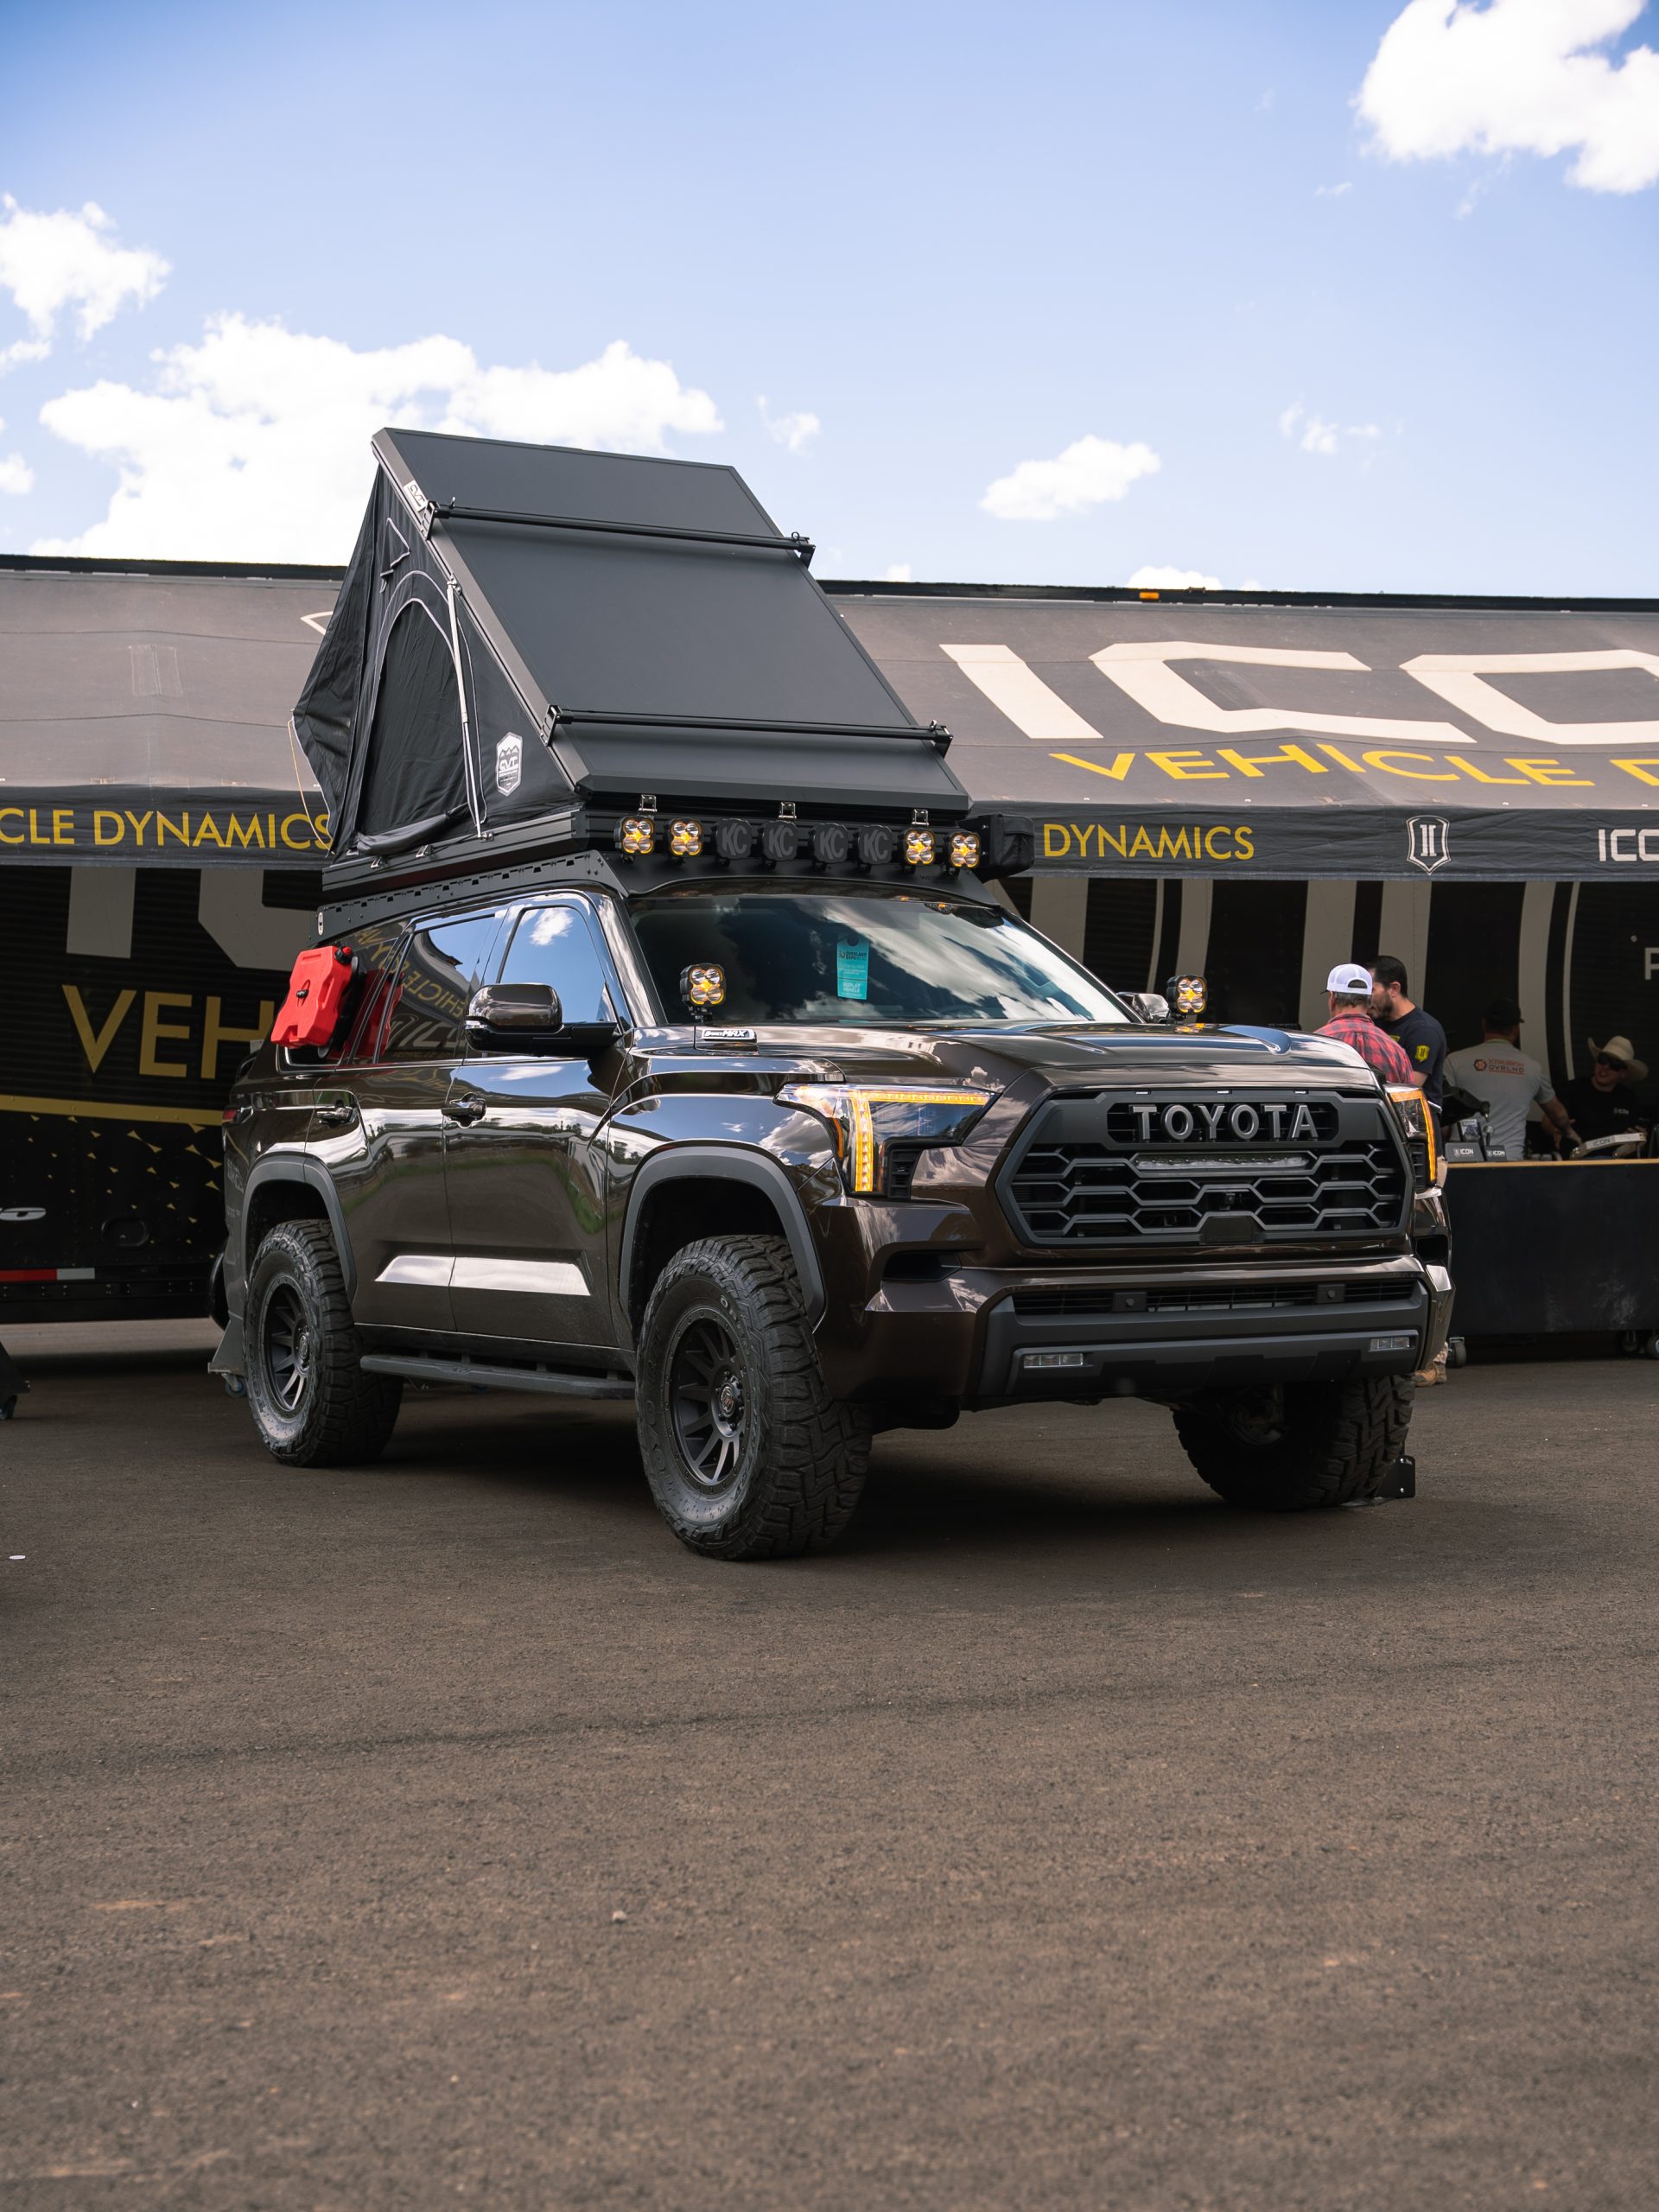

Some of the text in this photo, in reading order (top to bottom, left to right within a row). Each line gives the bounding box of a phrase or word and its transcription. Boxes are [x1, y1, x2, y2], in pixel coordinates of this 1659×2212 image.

[1048, 744, 1596, 786] VEHICLE
[0, 807, 334, 850] CLE DYNAMICS
[1043, 823, 1255, 860] DYNAMICS
[1130, 1104, 1319, 1141] TOYOTA
